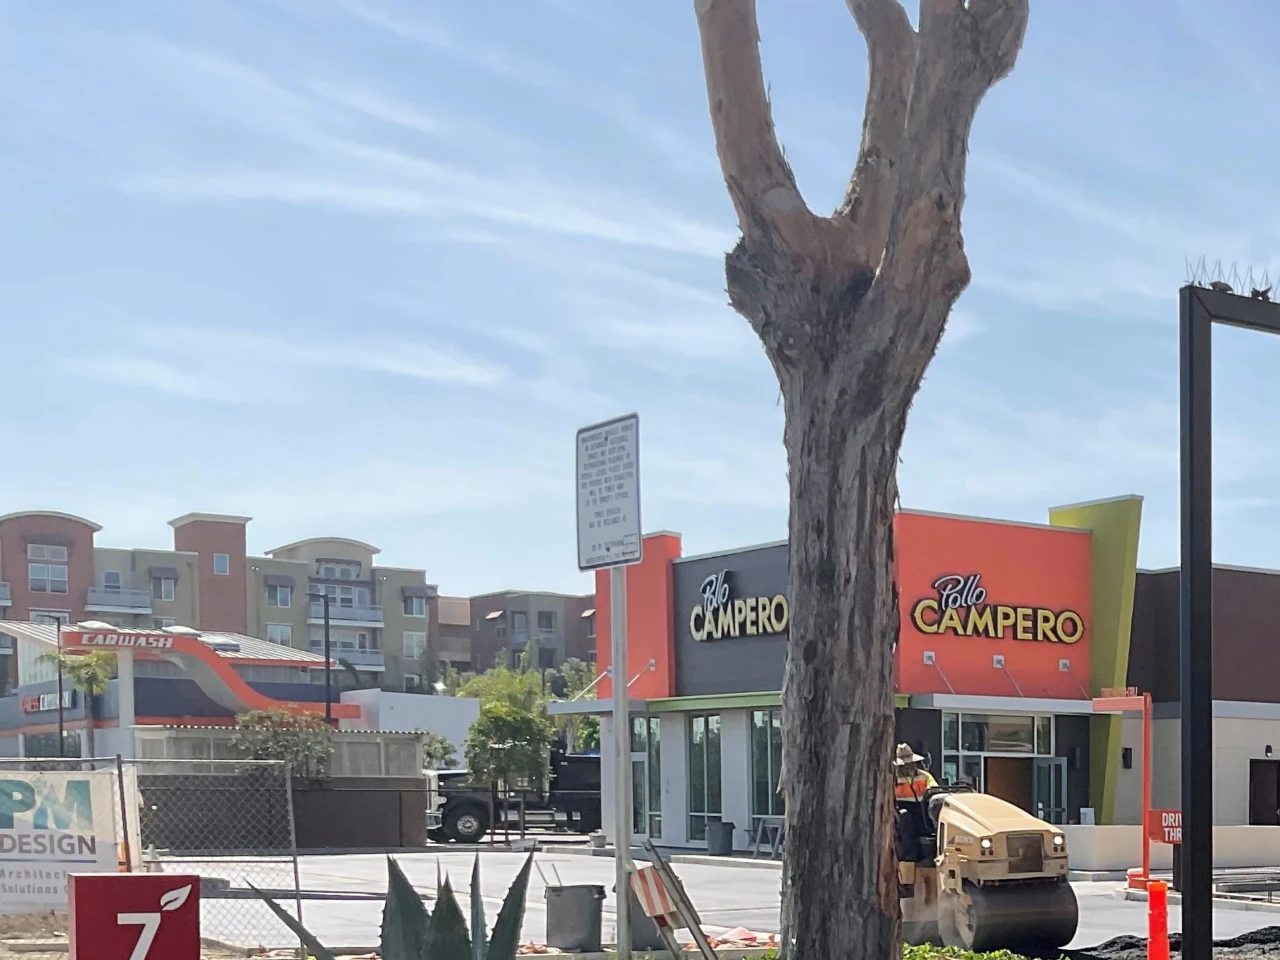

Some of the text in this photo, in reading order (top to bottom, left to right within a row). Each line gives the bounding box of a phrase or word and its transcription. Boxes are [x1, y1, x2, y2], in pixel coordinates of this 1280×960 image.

[700, 568, 730, 612] Pollo
[933, 573, 988, 610] Pollo
[689, 594, 789, 641] CAMPERO
[911, 597, 1085, 645] CAMPERO
[1162, 812, 1182, 827] DRIV
[0, 834, 97, 855] DESIGN
[1163, 827, 1182, 842] THR
[0, 868, 68, 879] Architect
[1, 883, 59, 894] Solutions
